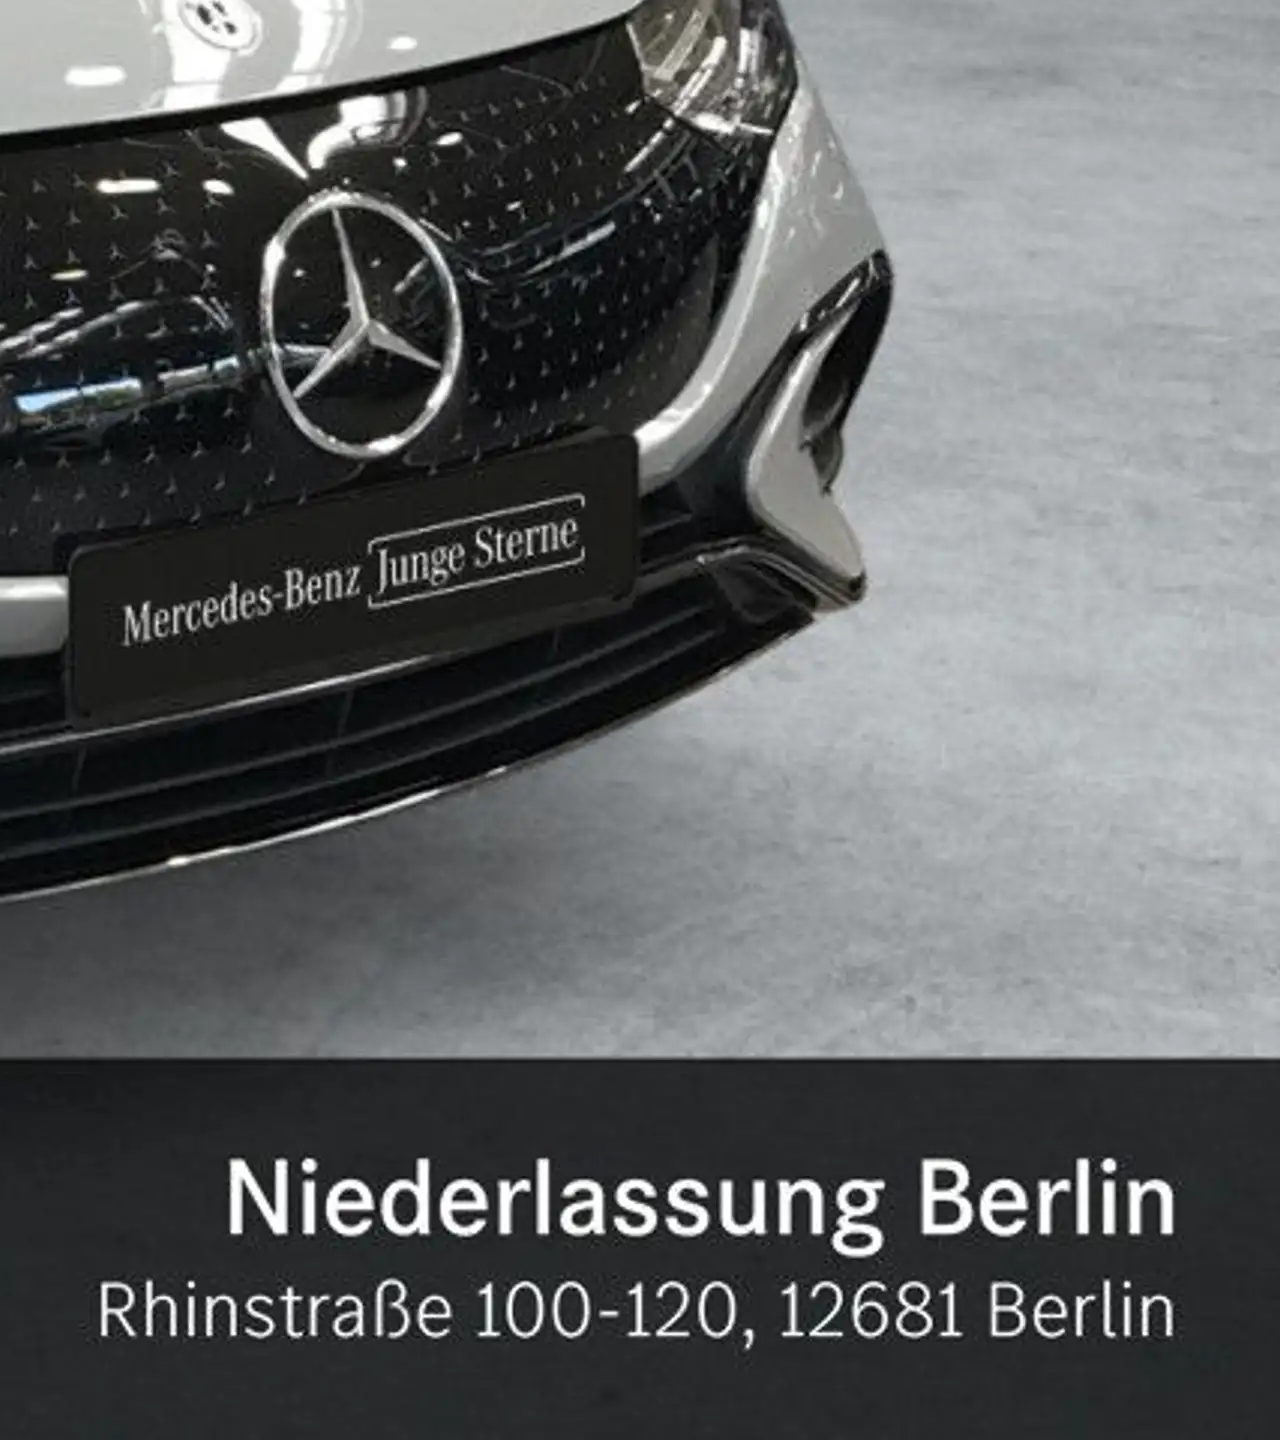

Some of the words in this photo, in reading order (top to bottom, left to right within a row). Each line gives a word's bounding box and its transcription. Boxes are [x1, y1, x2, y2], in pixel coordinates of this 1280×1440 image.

[121, 562, 361, 648] Mercedes-Benz
[375, 539, 466, 596] Junge
[473, 513, 579, 569] Sterne
